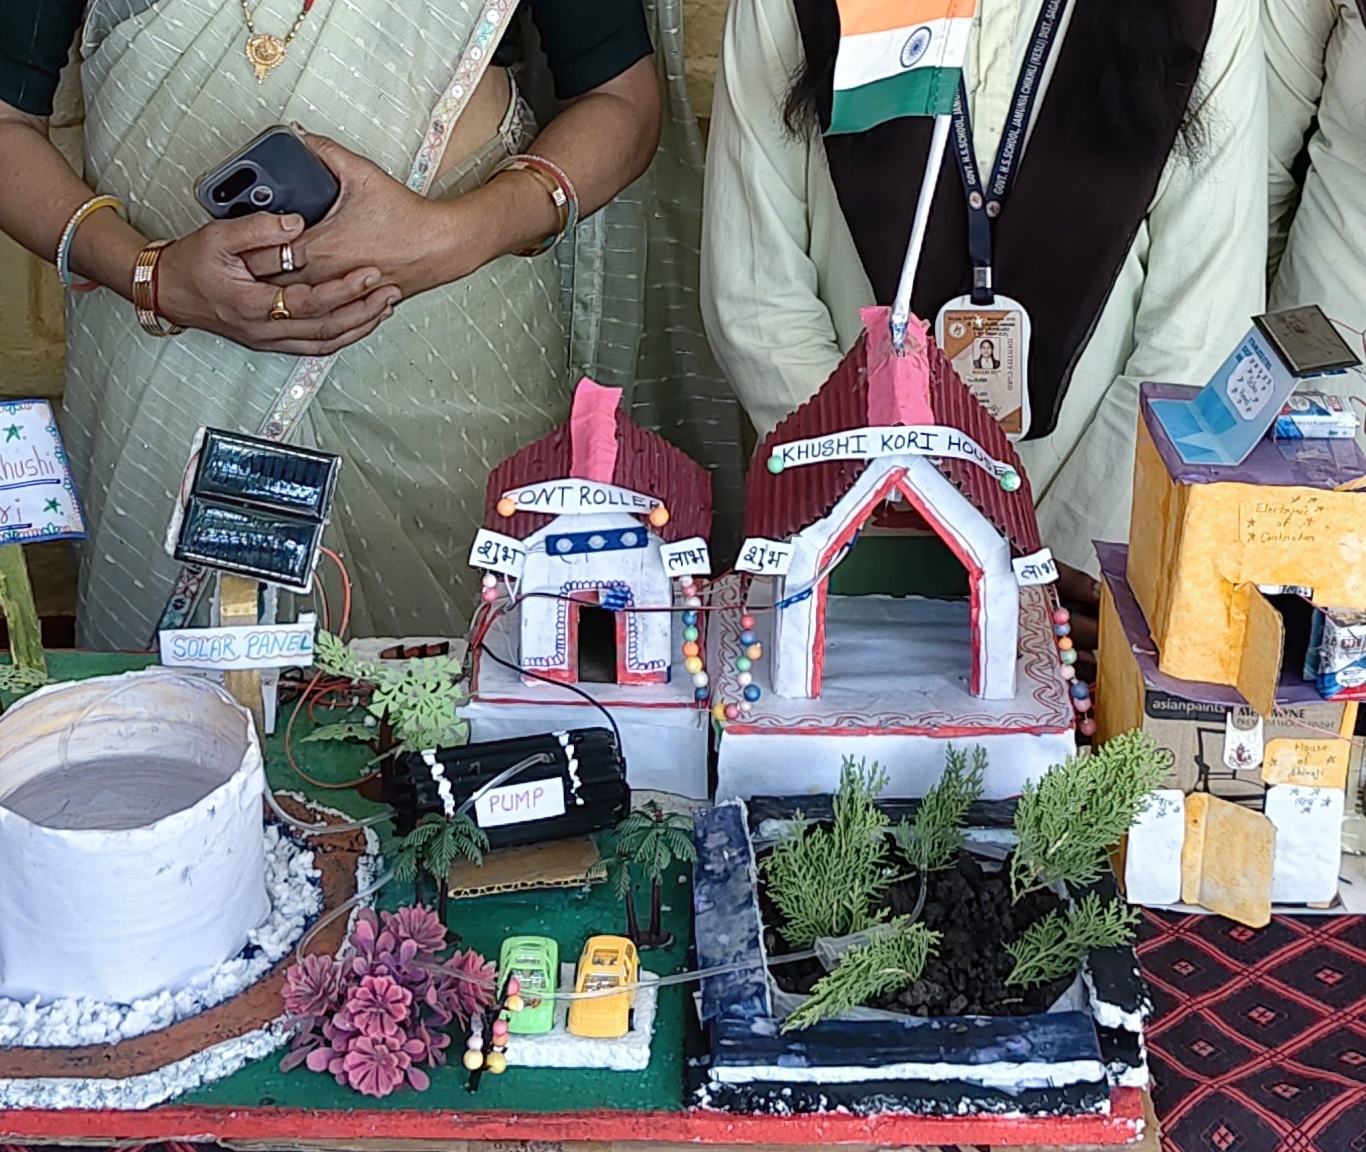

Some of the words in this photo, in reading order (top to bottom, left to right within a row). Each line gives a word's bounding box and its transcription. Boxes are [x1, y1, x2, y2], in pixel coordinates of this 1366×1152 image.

[993, 172, 1008, 195] GOVT.
[1011, 94, 1029, 128] JAMUNIA
[1021, 65, 1038, 95] CHIKHLI
[782, 434, 868, 462] KHUSHI
[880, 431, 939, 452] KORI
[947, 435, 1008, 477] HOUSE
[477, 540, 525, 565] शुभ
[667, 547, 707, 569] लाभ
[742, 543, 788, 570] शुभ
[1021, 558, 1055, 581] लाभ
[172, 636, 236, 658] SOLAR
[247, 633, 312, 657] PANEL
[1152, 698, 1226, 716] asianpaints
[488, 787, 544, 814] PUMP
